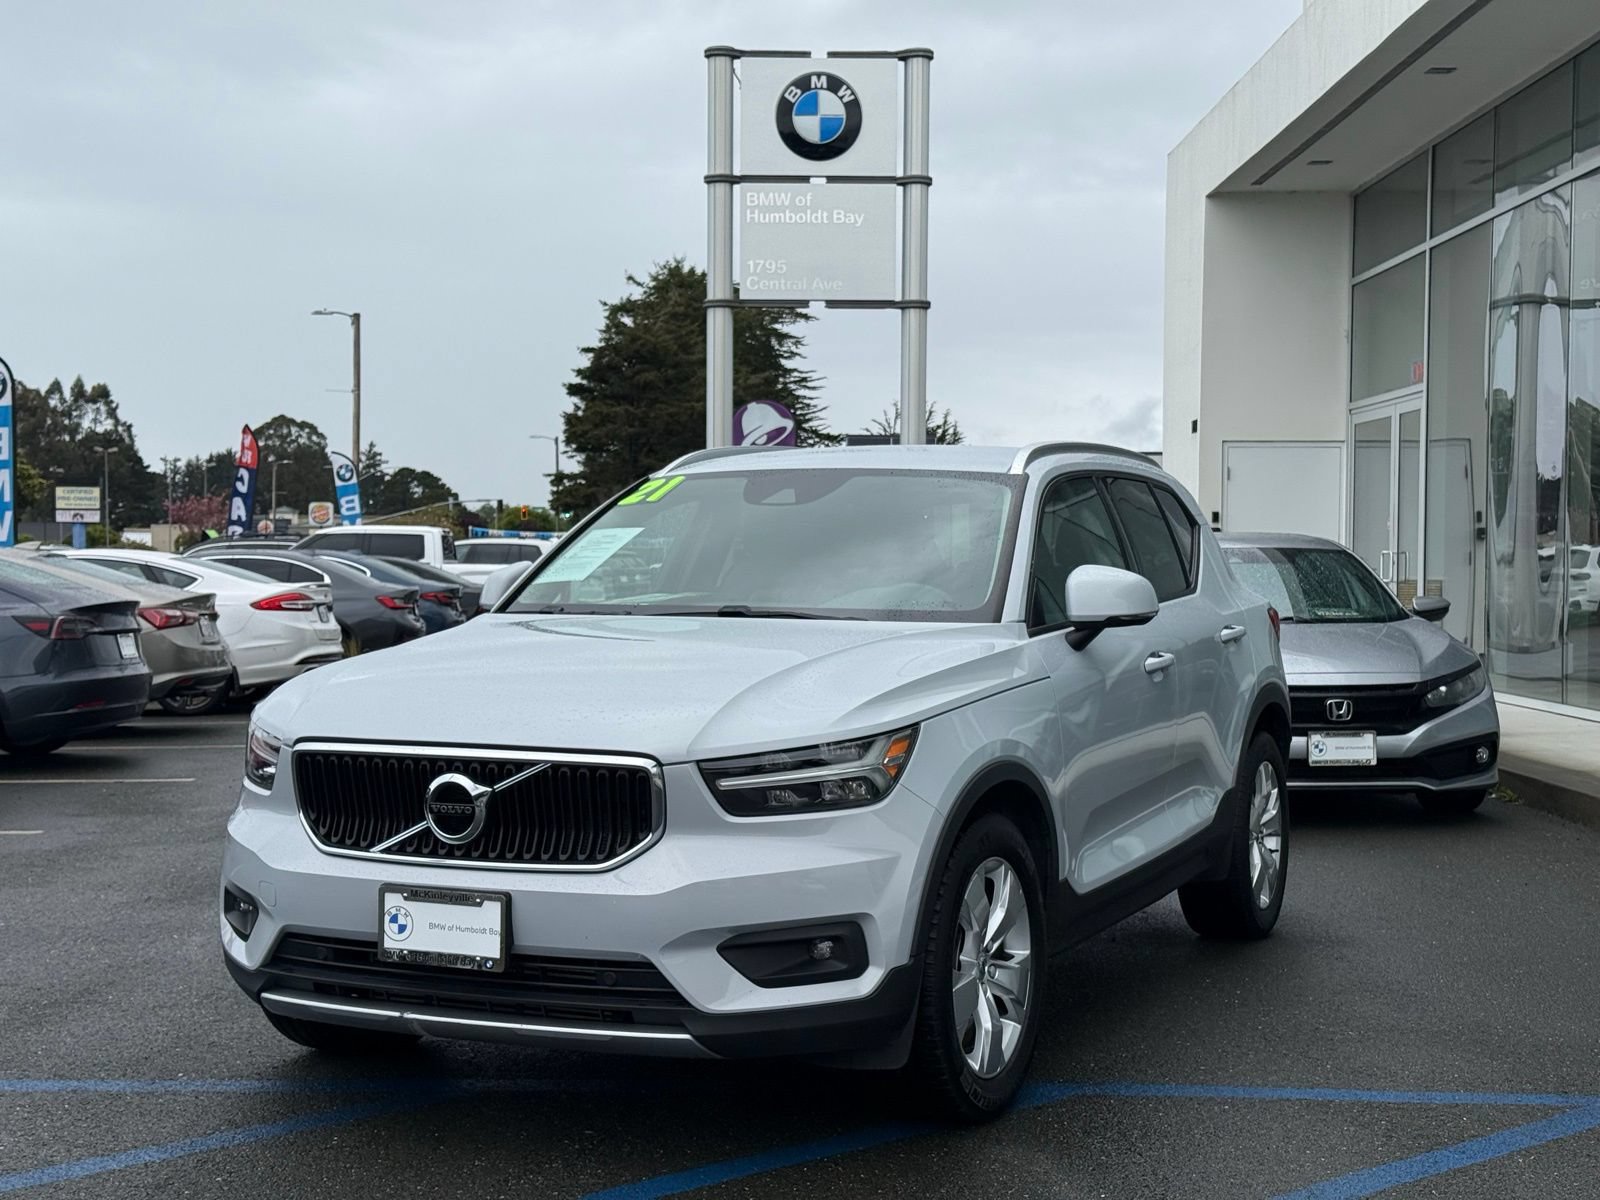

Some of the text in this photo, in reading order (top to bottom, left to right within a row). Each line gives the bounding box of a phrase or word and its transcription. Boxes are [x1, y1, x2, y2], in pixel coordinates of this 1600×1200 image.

[784, 75, 855, 104] BMW
[746, 191, 813, 206] BMW of
[746, 209, 865, 227] Humboldt Bay
[747, 259, 787, 273] 1795
[746, 276, 843, 291] Central Ave
[430, 804, 473, 814] VOLVO
[428, 922, 446, 931] BMW
[447, 923, 454, 931] of
[455, 925, 488, 935] Humboldt
